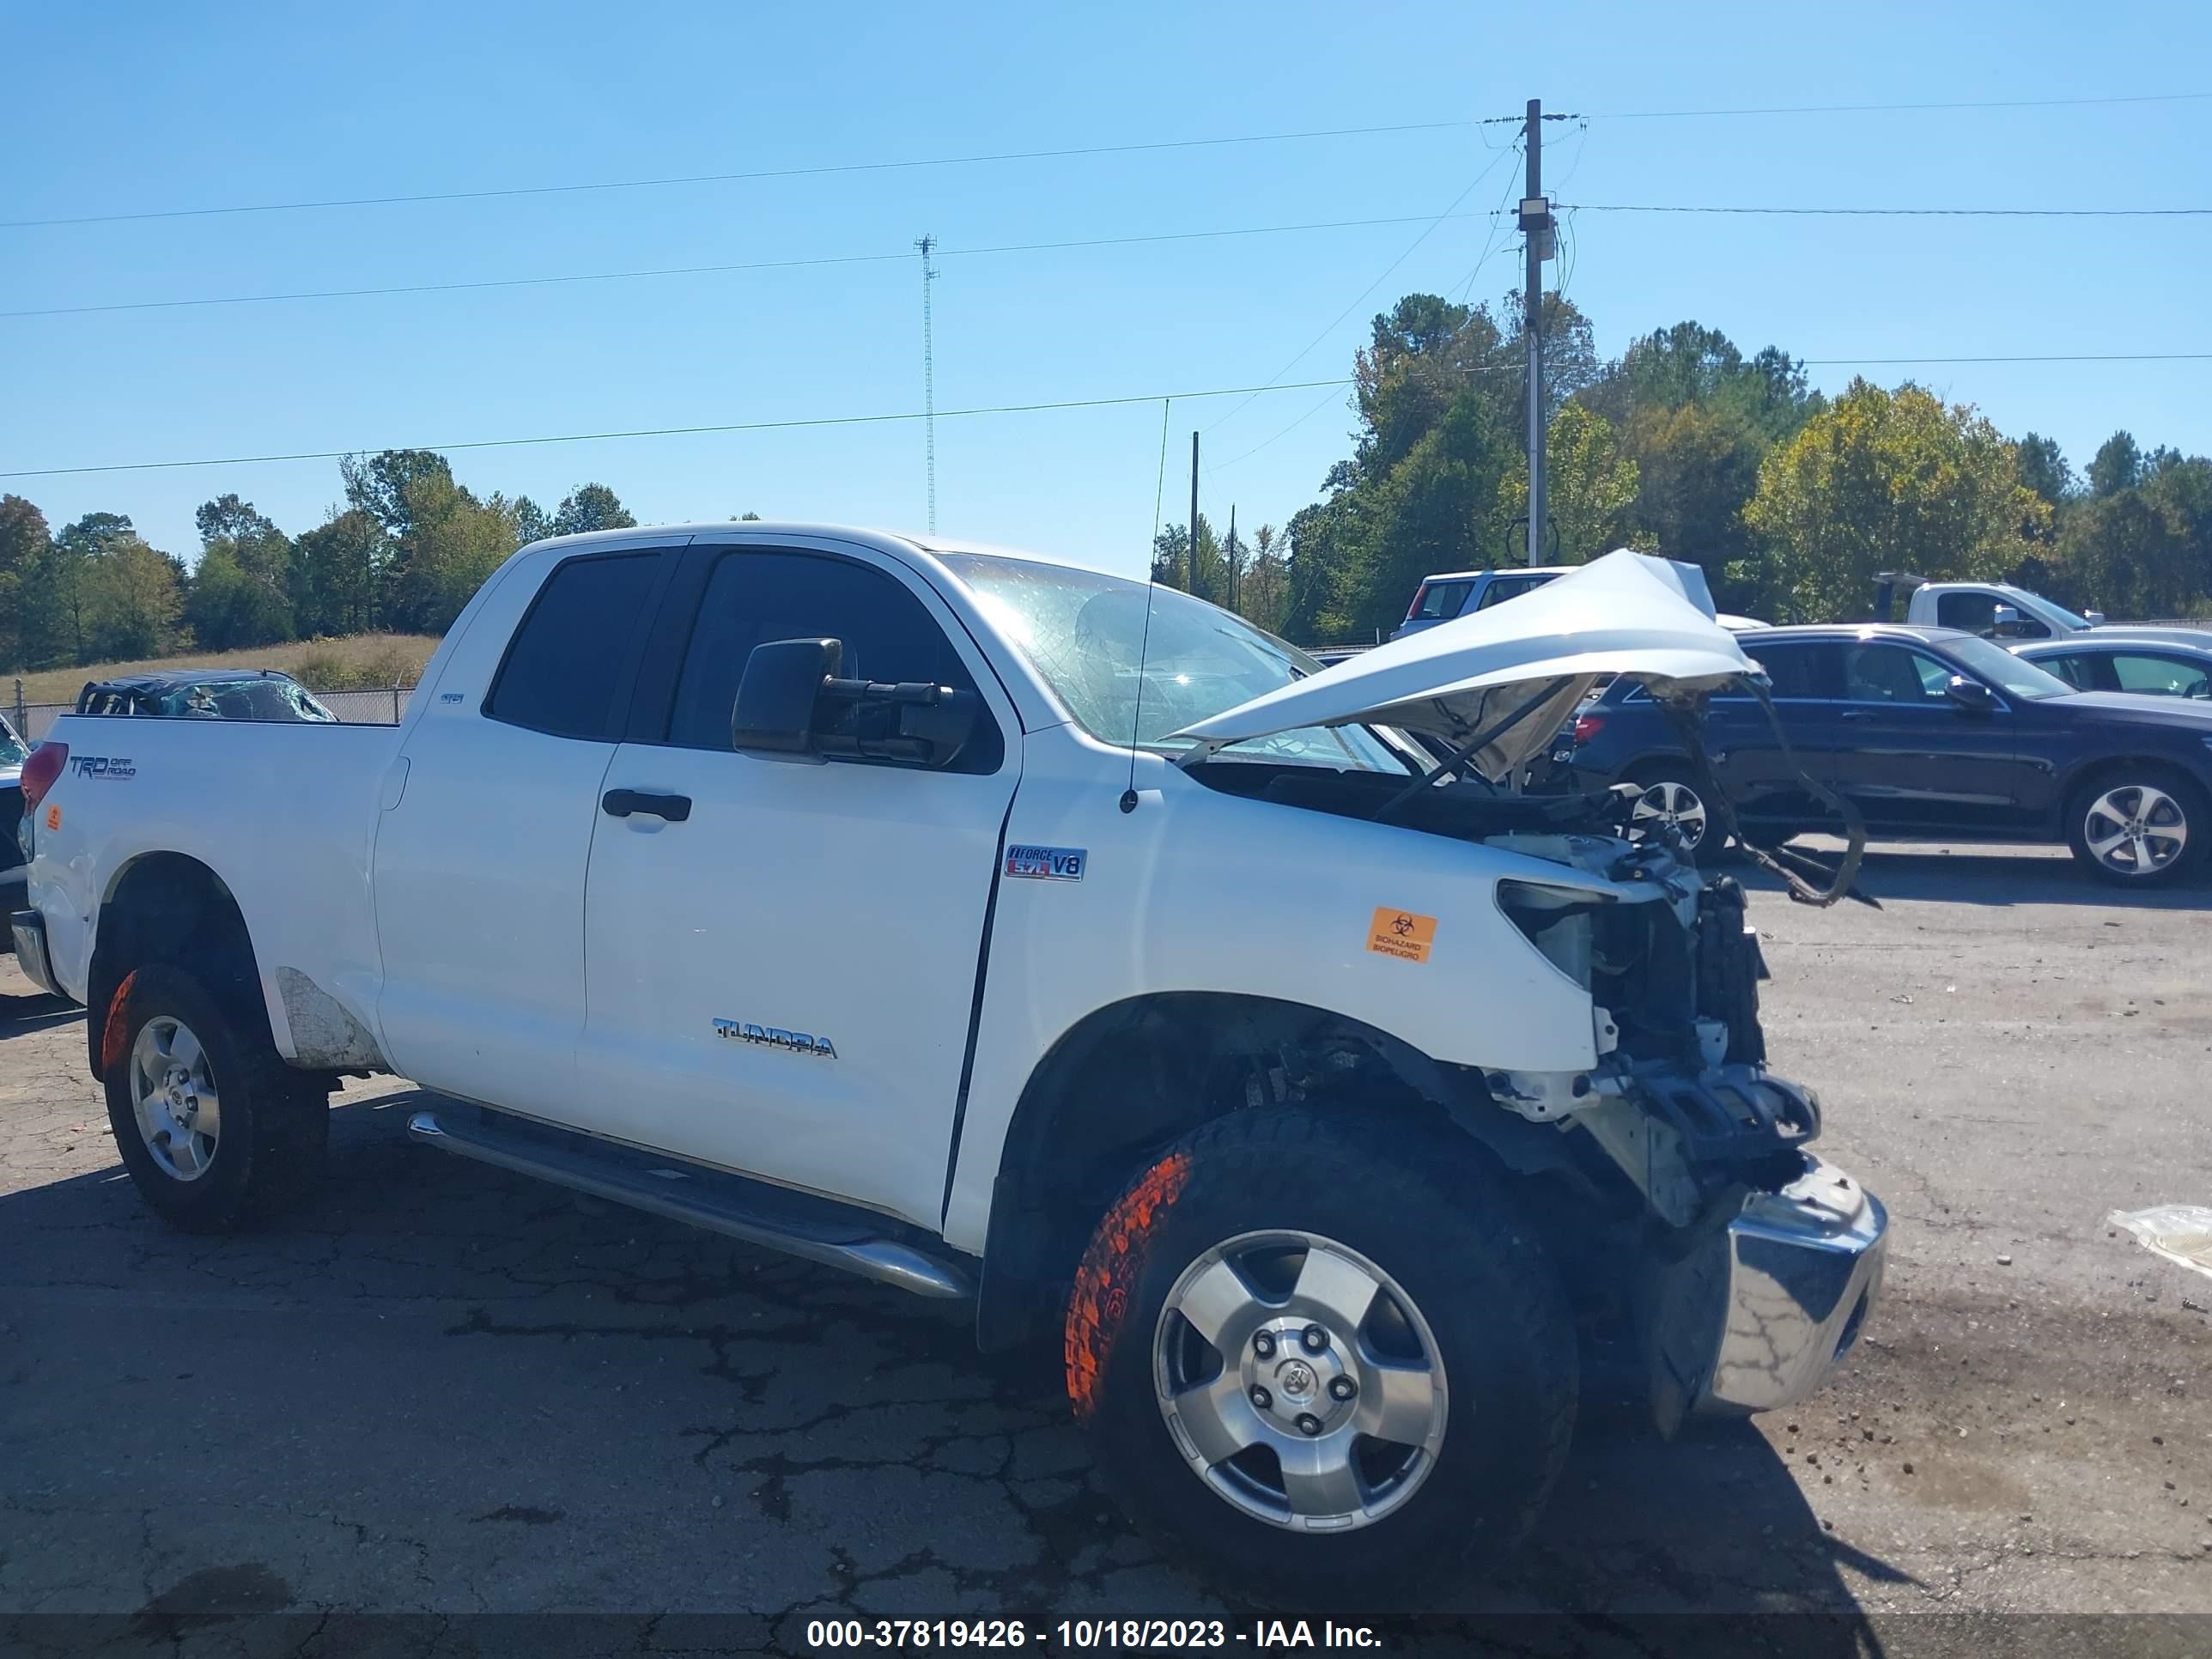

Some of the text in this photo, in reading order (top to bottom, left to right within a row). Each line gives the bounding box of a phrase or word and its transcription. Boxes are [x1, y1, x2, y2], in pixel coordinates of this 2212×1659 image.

[70, 756, 108, 779] TRD
[107, 767, 137, 776] ROAD
[1054, 855, 1080, 875] V8
[1375, 934, 1421, 951] BIOHAZARD
[1373, 944, 1419, 960] BIOPELIGRO
[713, 1017, 838, 1060] TUNDRA
